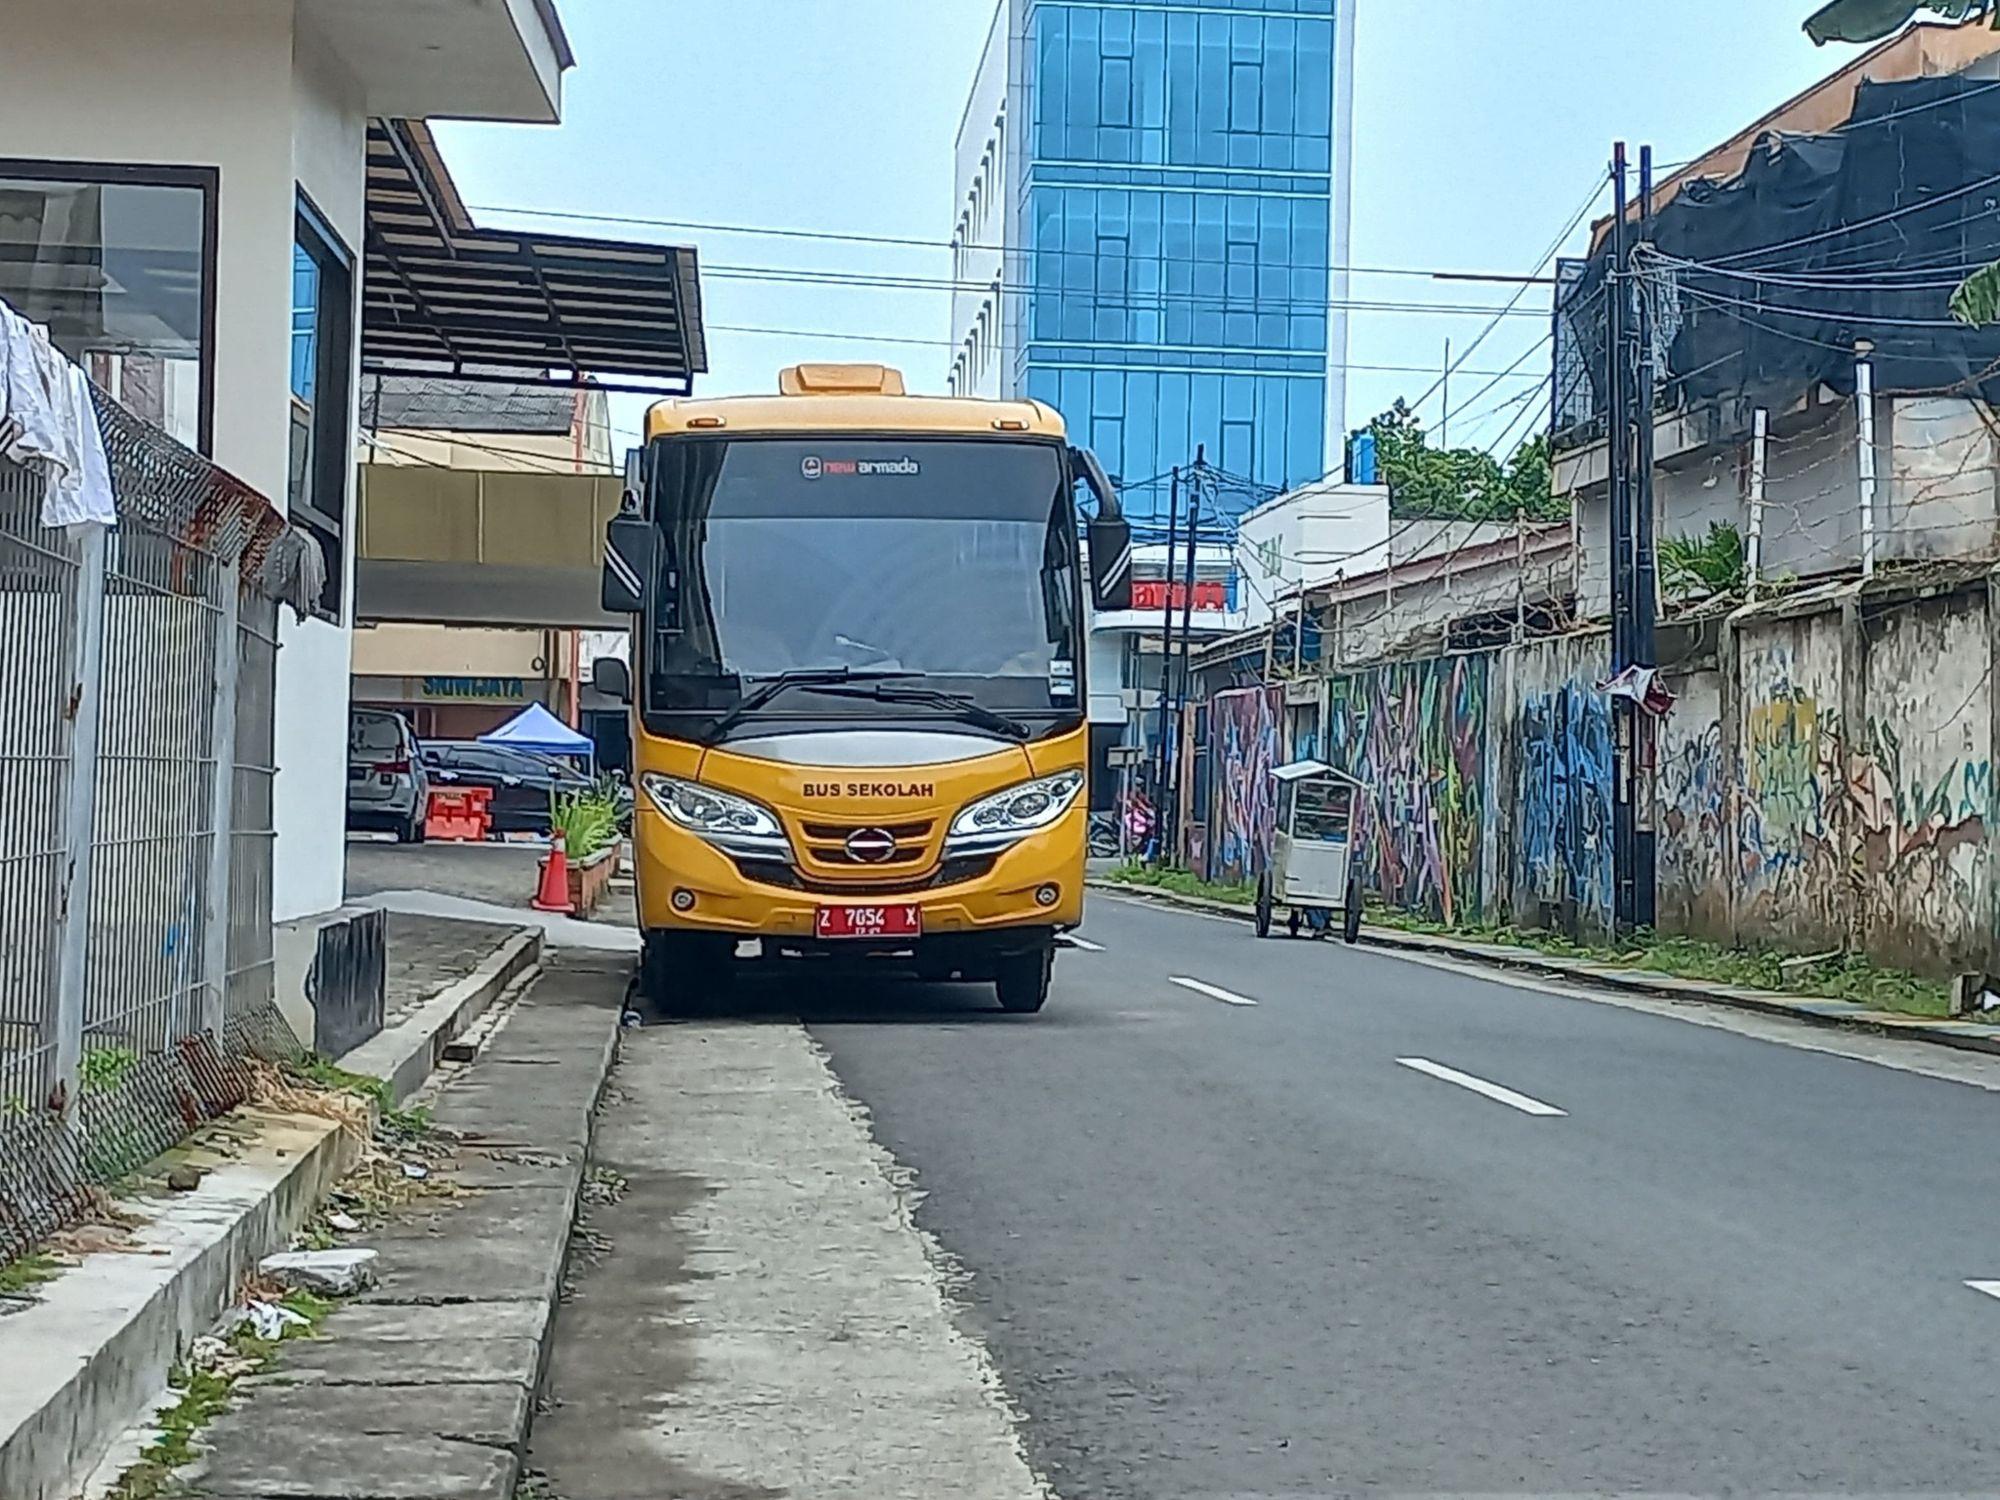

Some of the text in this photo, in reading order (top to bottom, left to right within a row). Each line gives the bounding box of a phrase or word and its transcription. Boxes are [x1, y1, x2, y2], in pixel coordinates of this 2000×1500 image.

[858, 457, 919, 474] armada
[803, 783, 934, 798] BUS SEKOLAH
[820, 907, 917, 927] Z 7054 X
